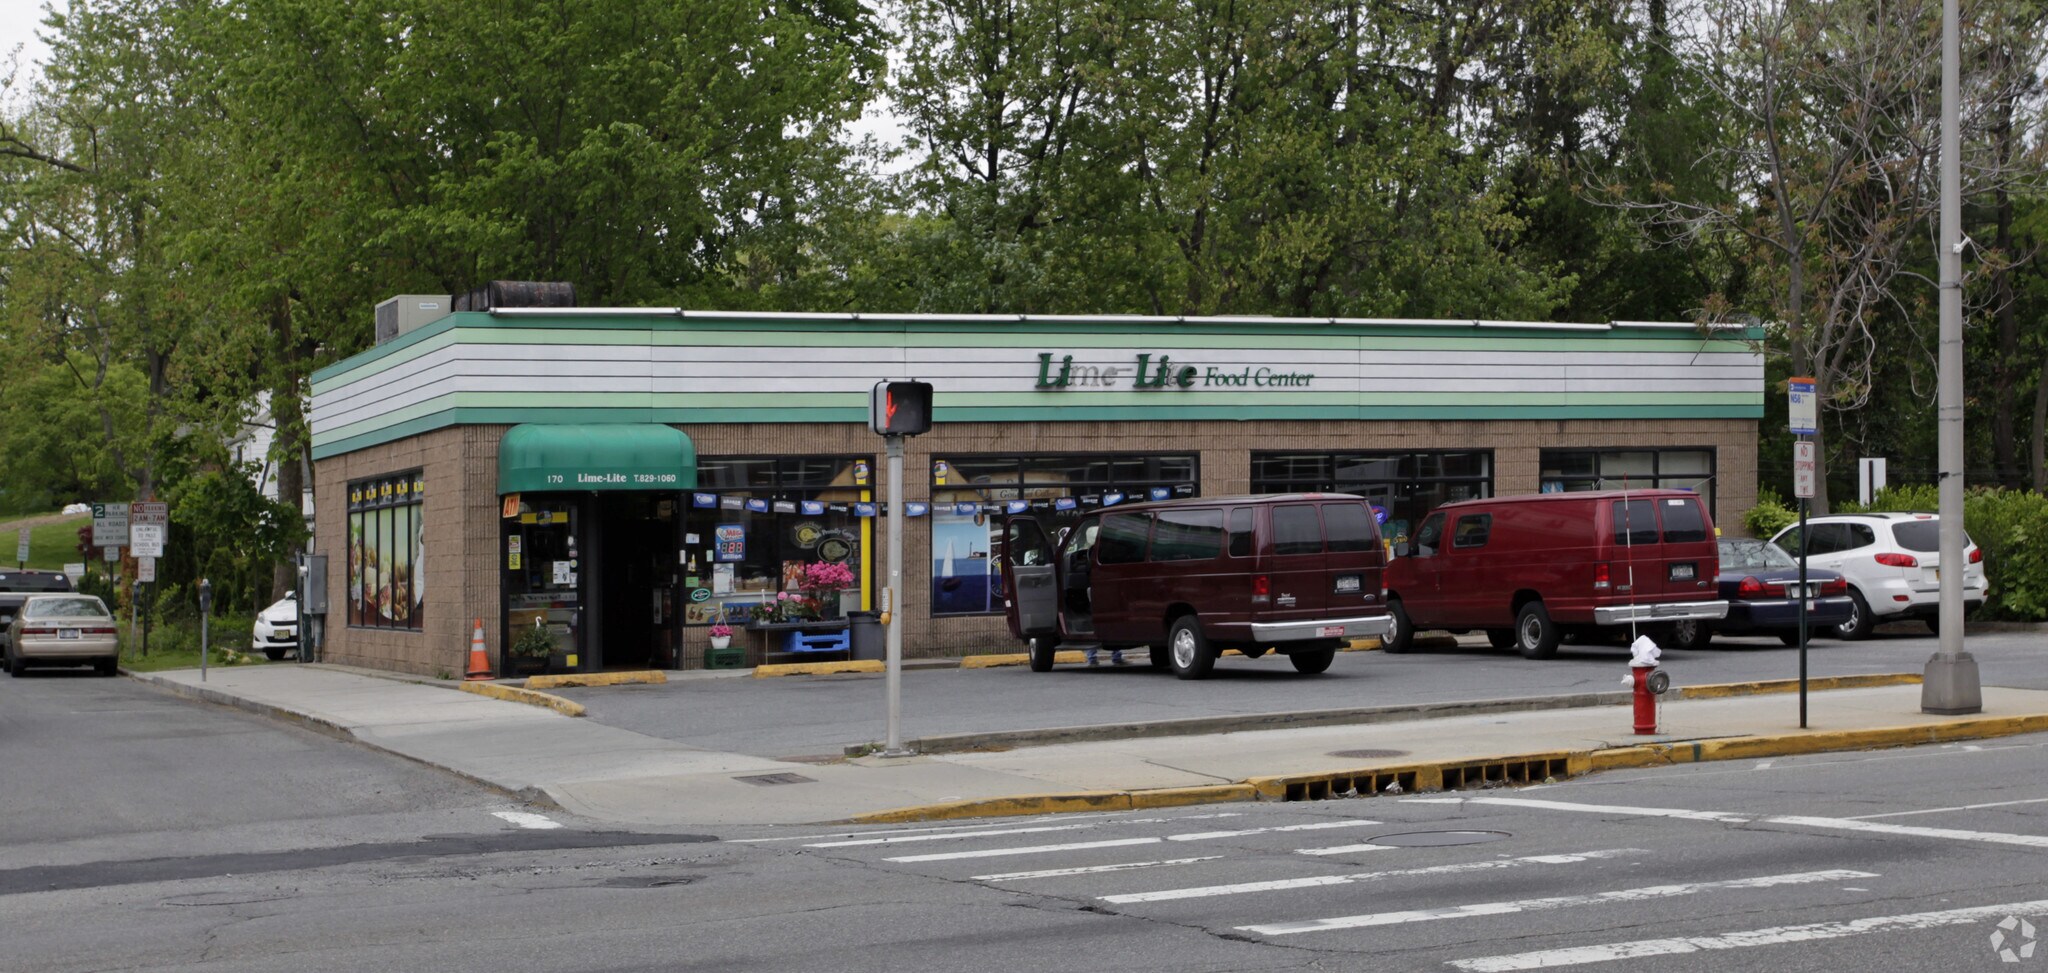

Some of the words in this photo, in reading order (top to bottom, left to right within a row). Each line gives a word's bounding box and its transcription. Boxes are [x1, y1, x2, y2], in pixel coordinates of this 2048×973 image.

[1204, 367, 1250, 387] Food
[1255, 367, 1315, 387] Center
[547, 475, 563, 483] 170
[578, 473, 627, 483] Lime-Lite
[94, 506, 104, 517] 2
[133, 504, 144, 513] NO
